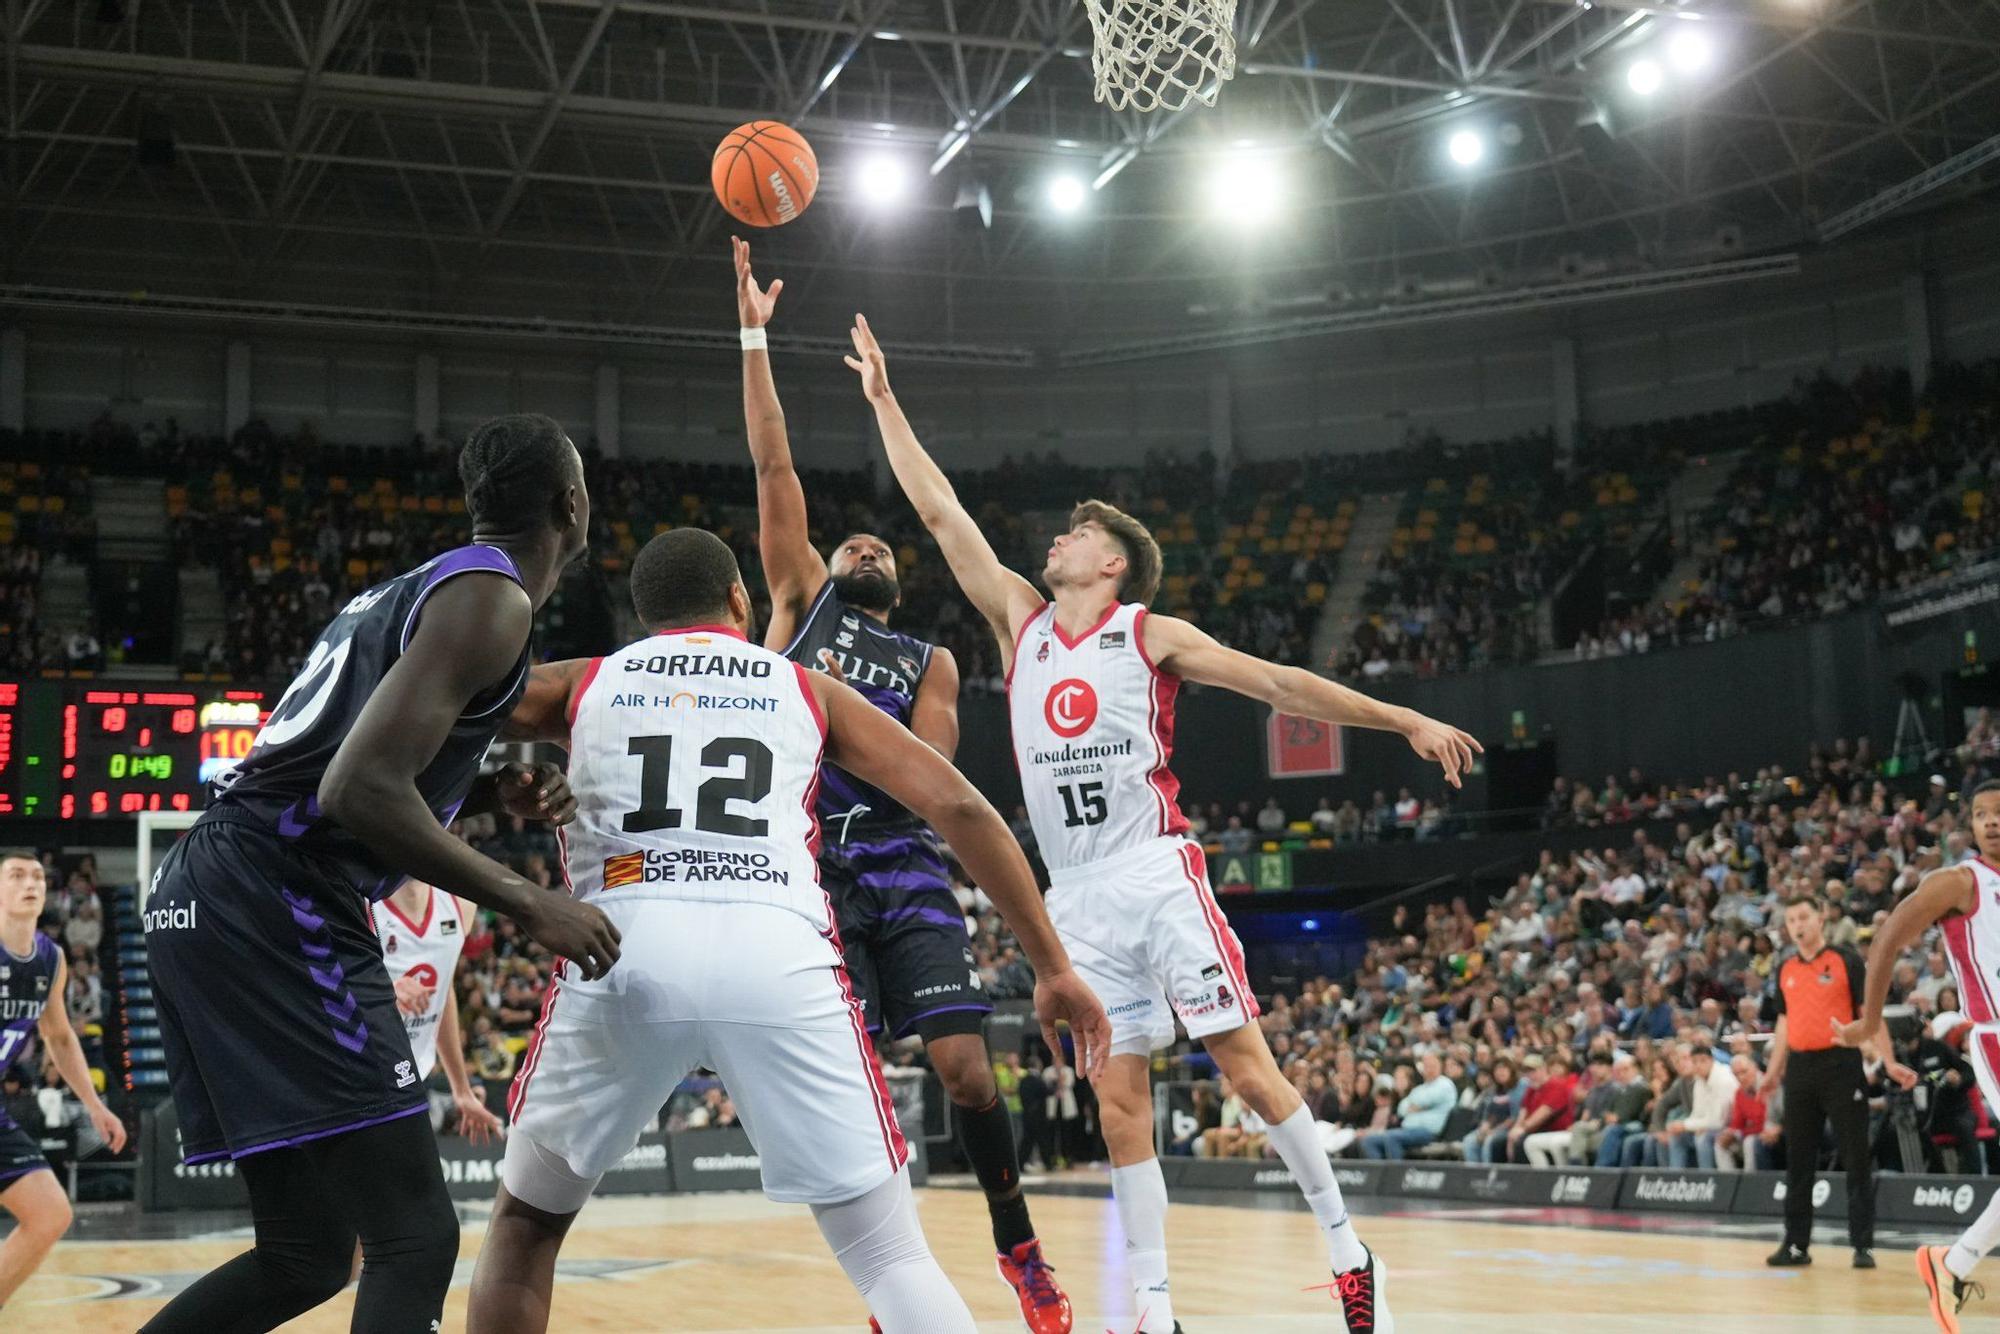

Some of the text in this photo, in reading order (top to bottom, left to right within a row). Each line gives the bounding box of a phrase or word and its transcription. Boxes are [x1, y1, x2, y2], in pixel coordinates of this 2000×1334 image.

[624, 654, 771, 678] SORIANO
[813, 647, 913, 700] surn
[610, 692, 779, 712] AIR HORIZONT
[1027, 738, 1133, 764] Casademont
[109, 753, 172, 779] 01:49
[1053, 763, 1103, 777] ZARAGOZA
[622, 735, 774, 837] 12
[1058, 781, 1108, 828] 15
[646, 849, 770, 867] GOBIERNO
[644, 865, 789, 886] DE ARAGON
[143, 900, 196, 934] ancial
[913, 983, 962, 998] NISSAN
[0, 999, 47, 1020] urn
[1635, 1175, 1716, 1202] kutxabank
[1913, 1187, 1953, 1208] bbk
